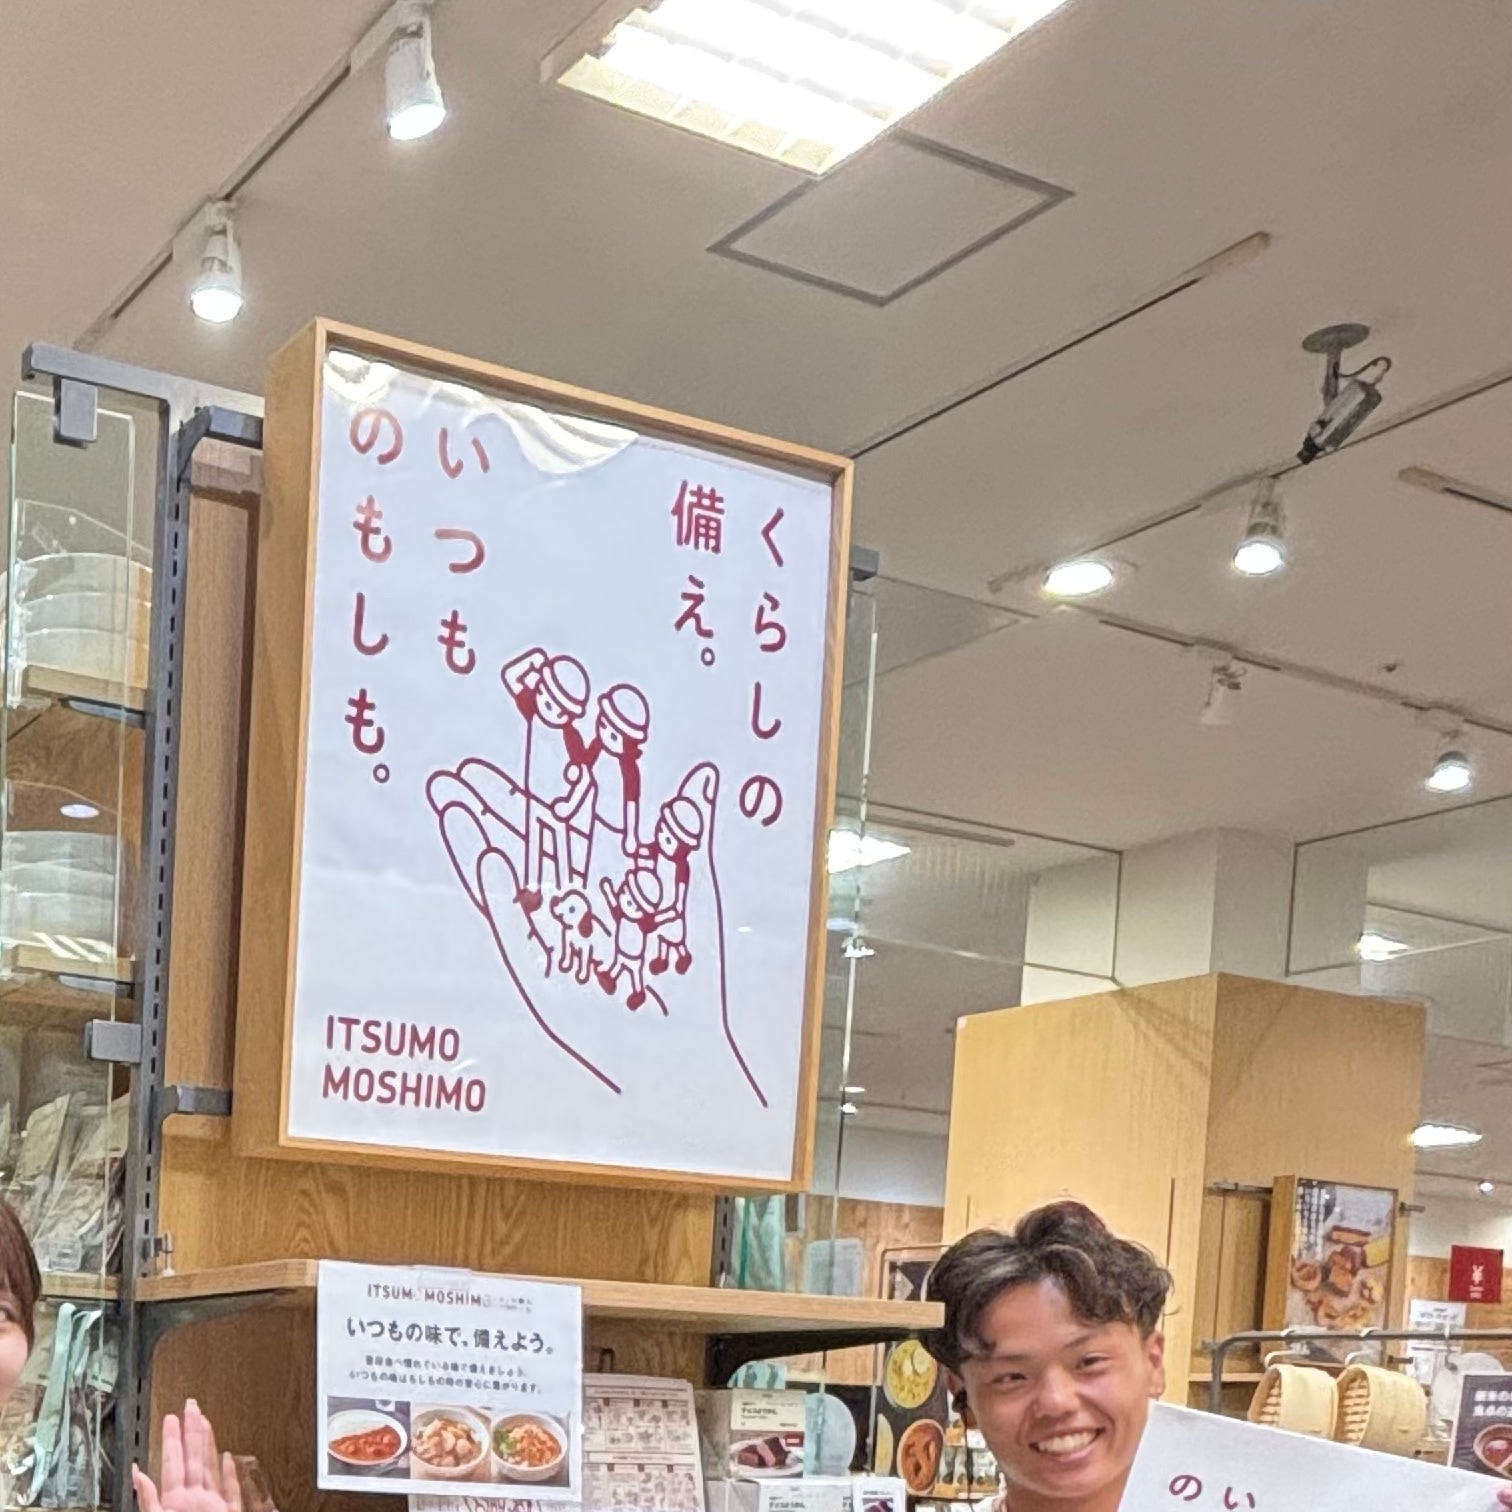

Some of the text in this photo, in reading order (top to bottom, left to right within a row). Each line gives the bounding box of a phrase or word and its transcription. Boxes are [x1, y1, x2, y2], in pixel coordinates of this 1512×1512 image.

[345, 408, 402, 784] のもしも。
[436, 428, 490, 674] いつも
[672, 480, 725, 667] 備え。
[740, 508, 787, 828] くらしの
[323, 1065, 486, 1113] MOSHIMO
[326, 1016, 460, 1062] ITSUMO
[346, 1317, 554, 1355] いつもの味で、備えよう。
